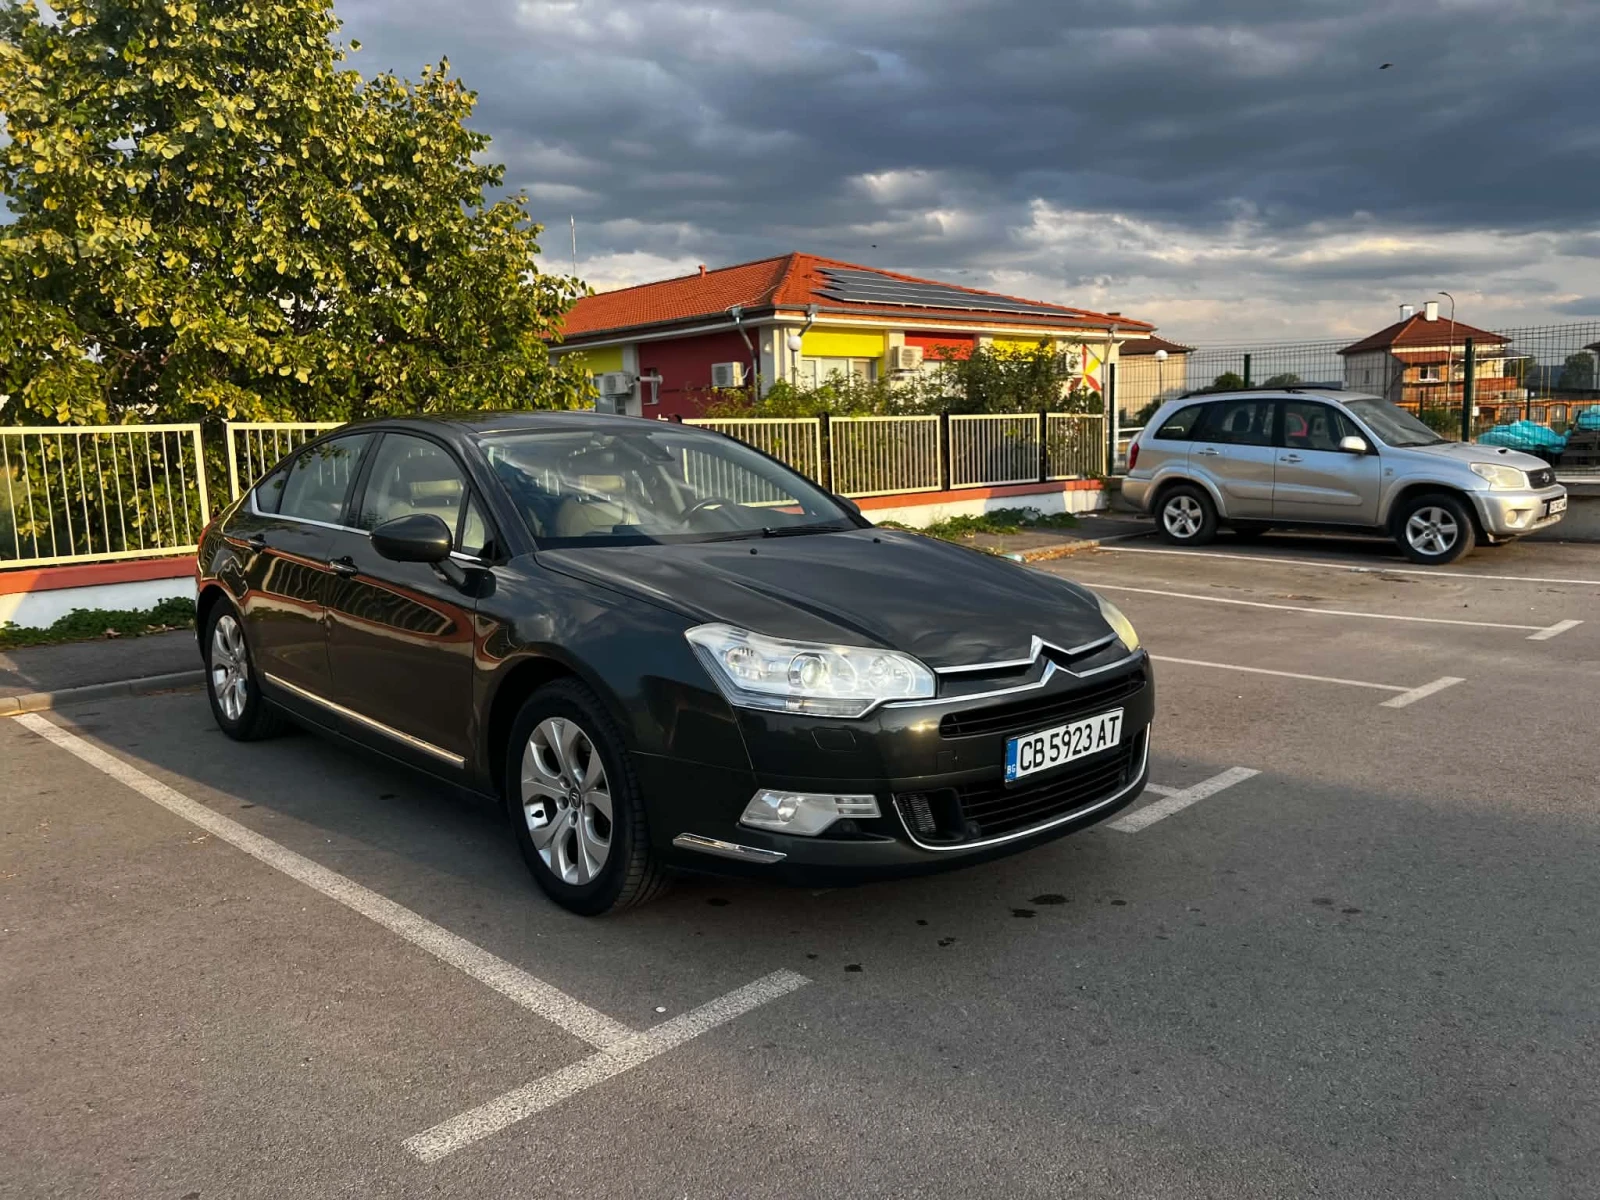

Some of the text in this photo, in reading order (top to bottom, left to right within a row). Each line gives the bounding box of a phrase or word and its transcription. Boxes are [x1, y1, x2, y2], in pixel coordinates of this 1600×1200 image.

[1020, 716, 1119, 771] CB 5923 AT
[1007, 764, 1016, 774] BG
